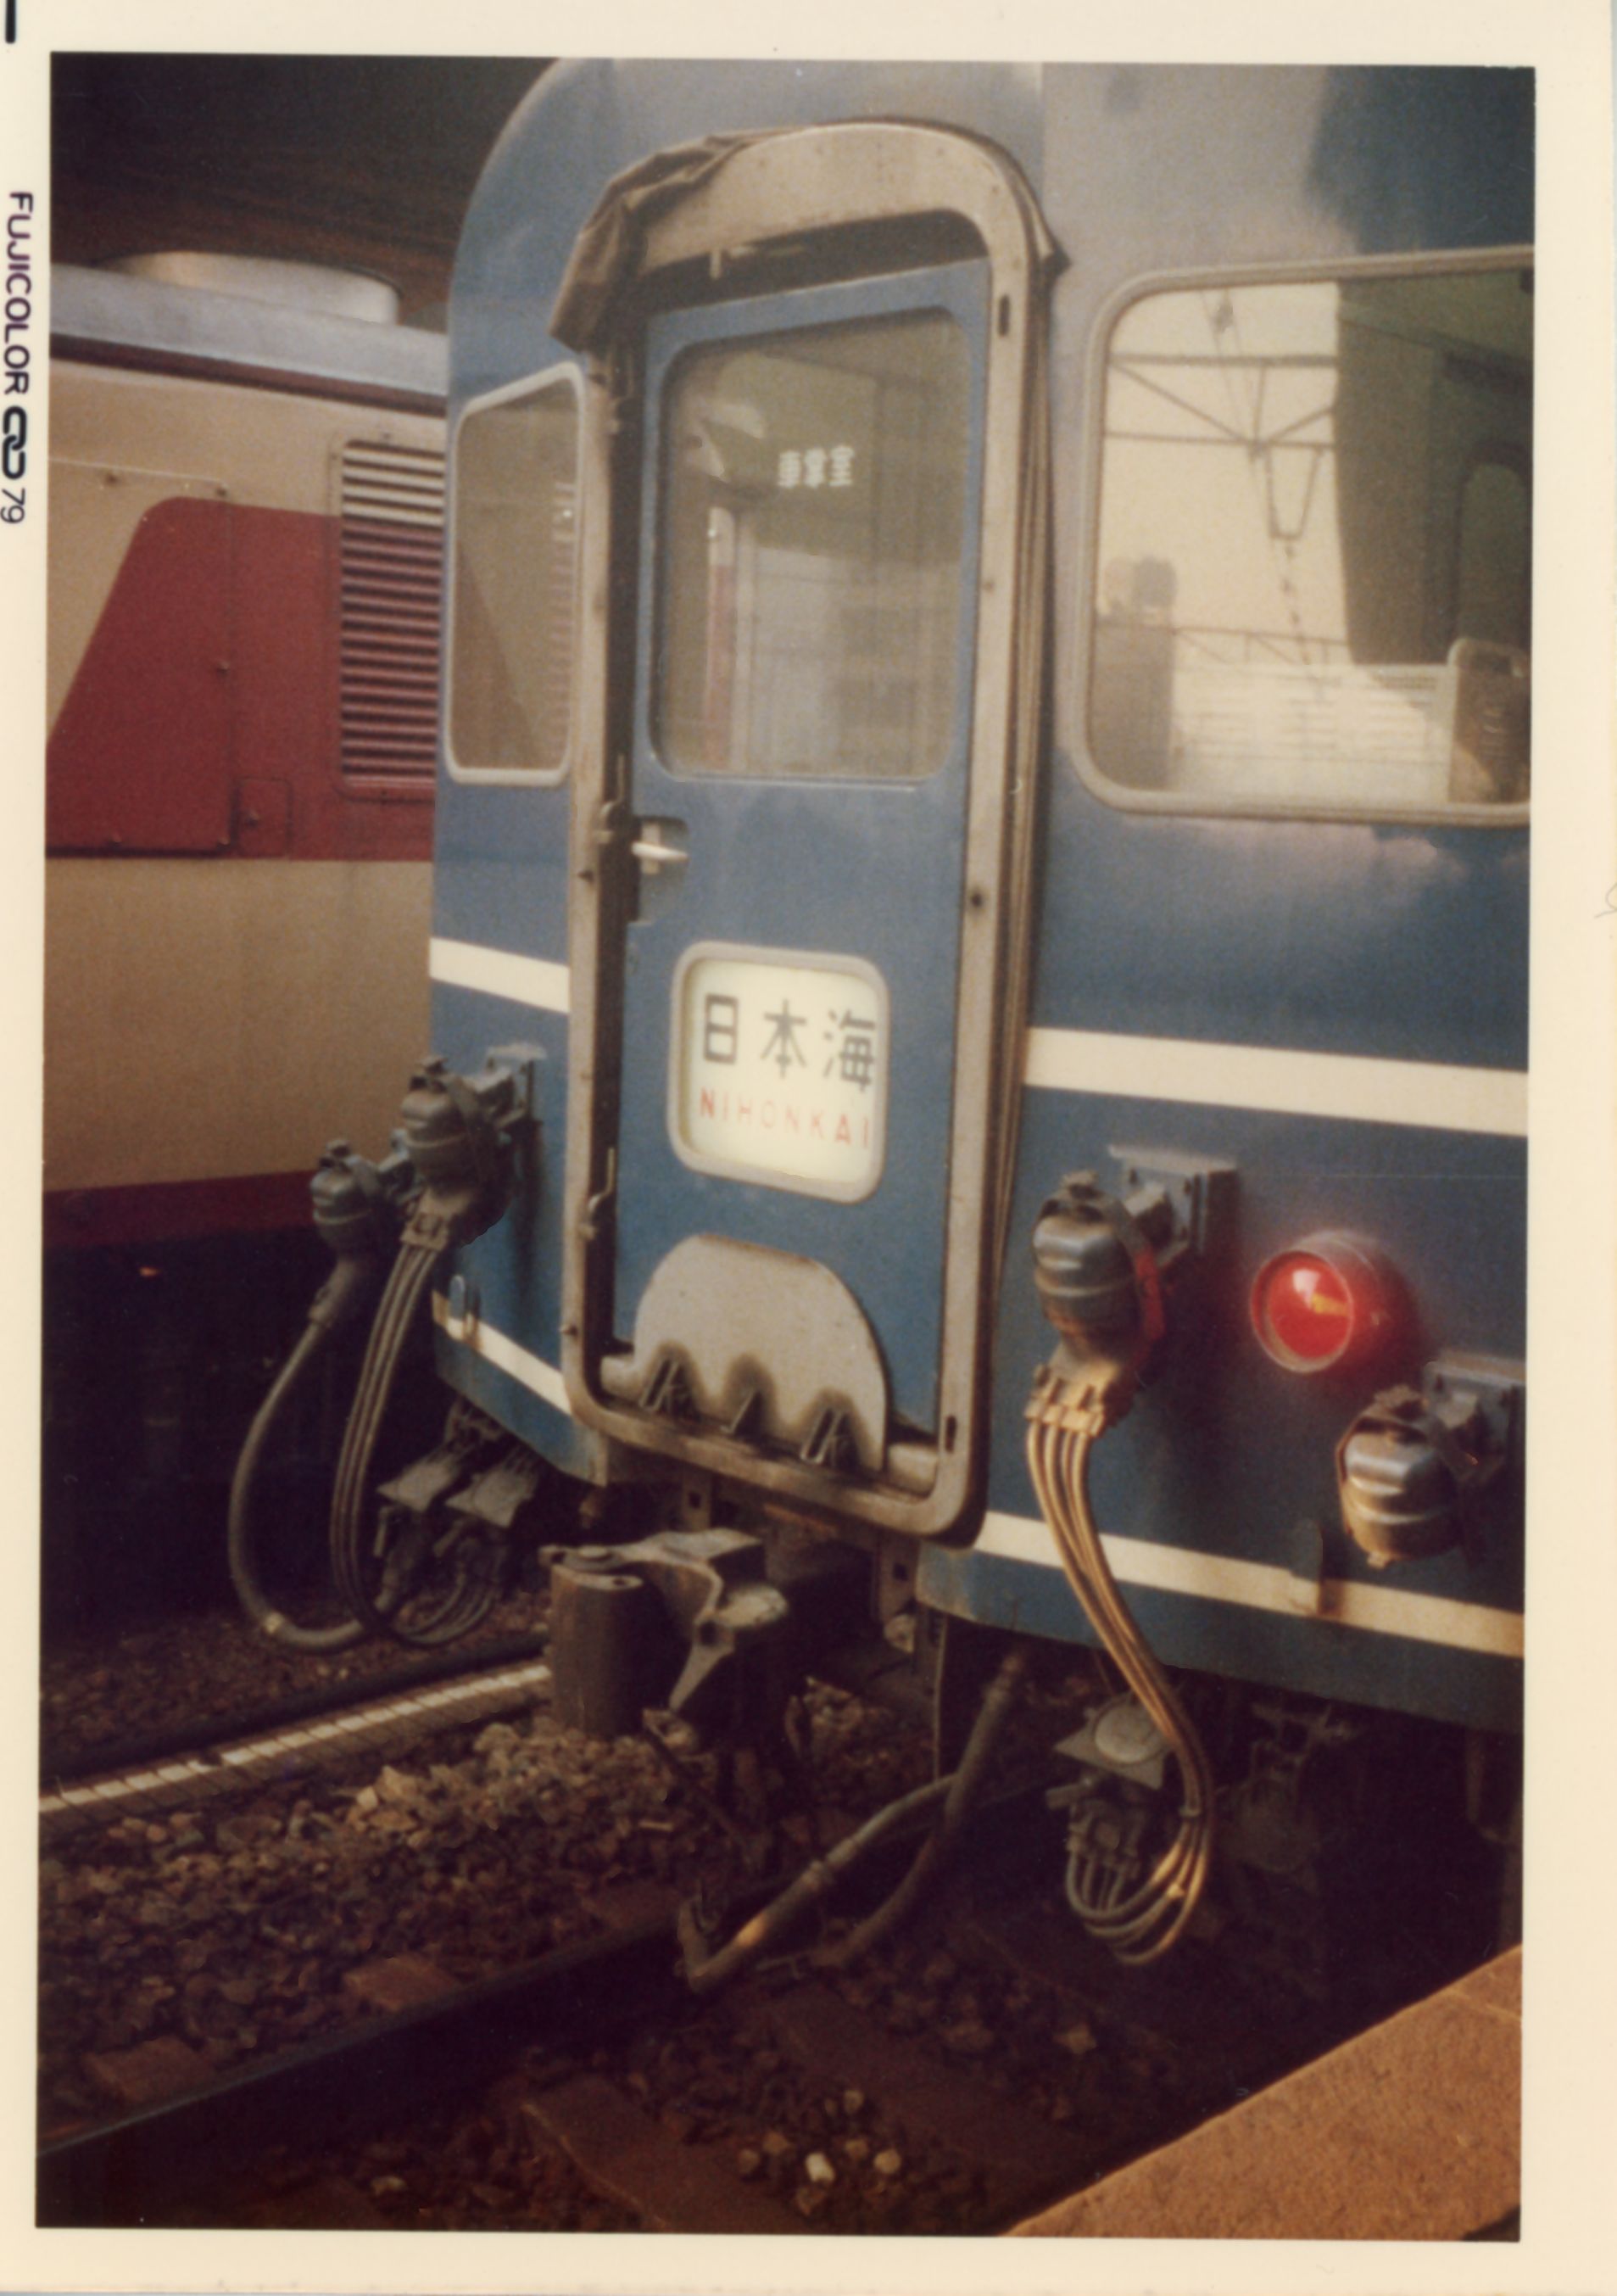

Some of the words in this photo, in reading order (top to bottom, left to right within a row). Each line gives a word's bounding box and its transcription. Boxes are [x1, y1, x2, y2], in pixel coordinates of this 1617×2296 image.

[703, 993, 877, 1093] 日本海
[699, 1087, 869, 1150] NIHONKAI
